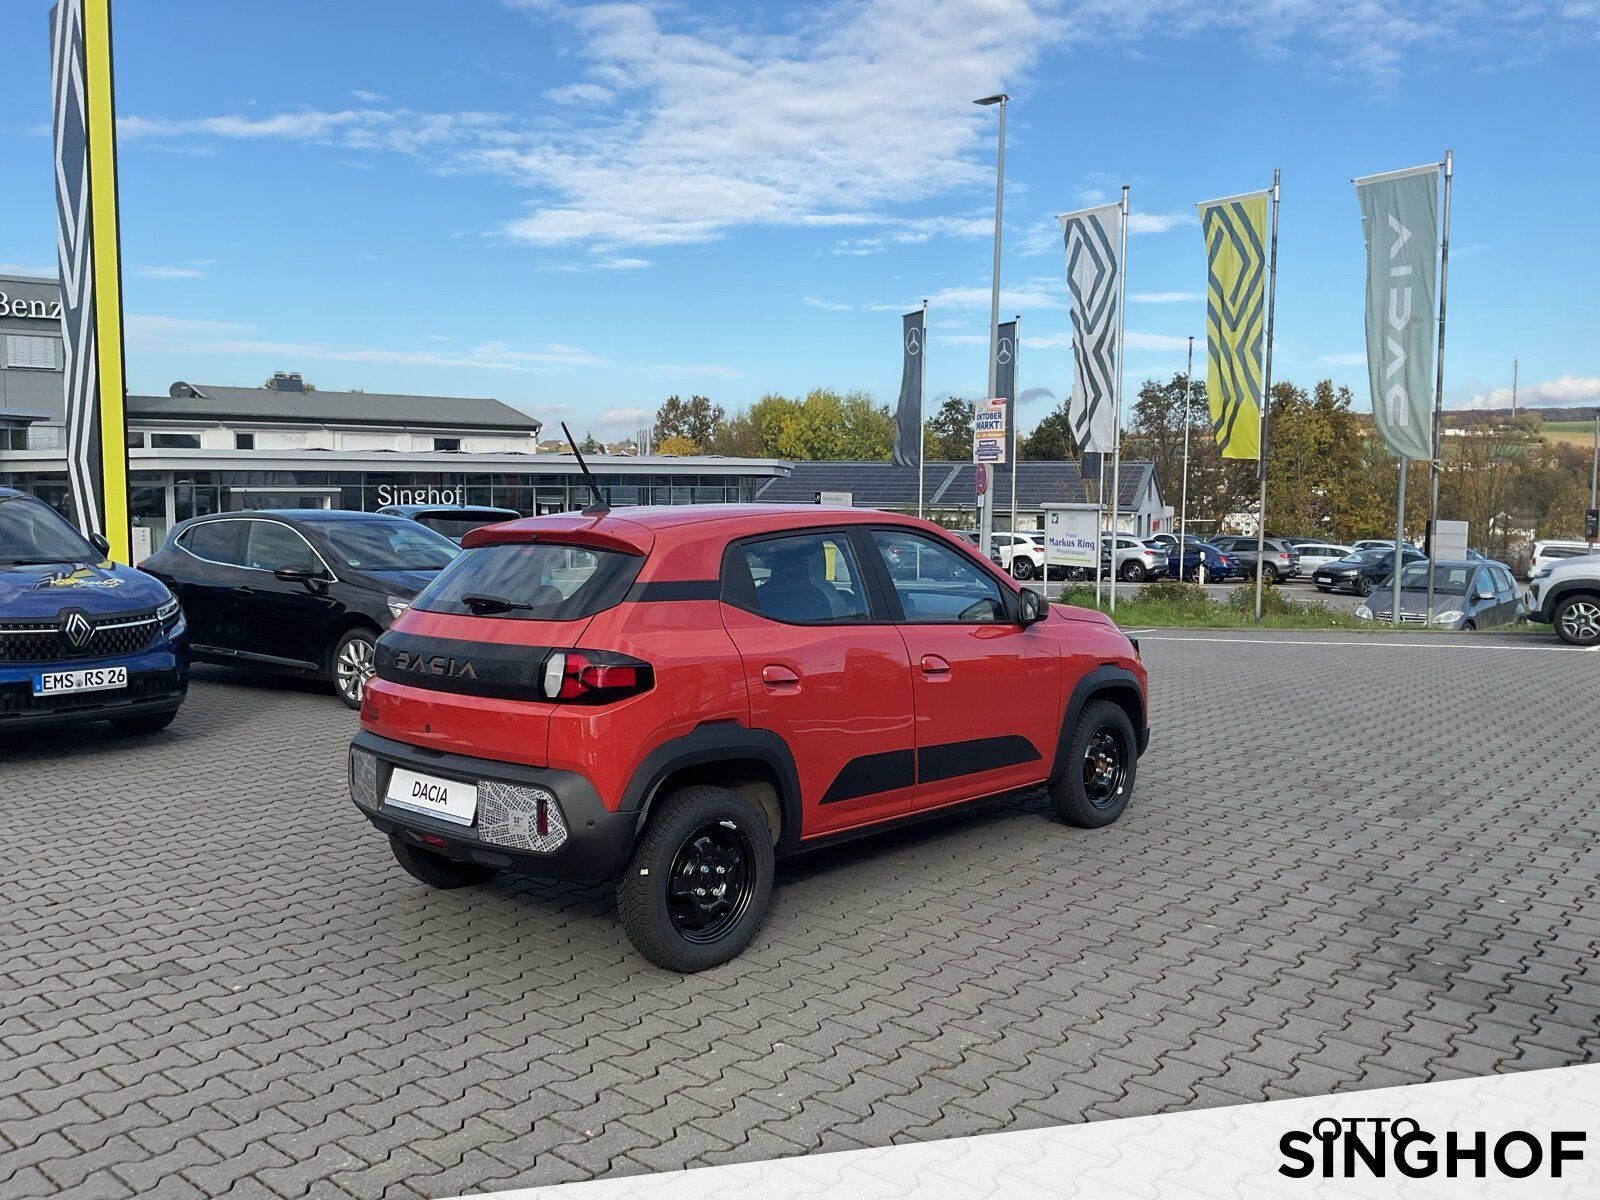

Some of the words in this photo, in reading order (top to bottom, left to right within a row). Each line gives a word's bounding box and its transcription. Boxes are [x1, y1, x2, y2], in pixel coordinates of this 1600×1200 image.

[377, 484, 463, 506] Singhof
[1049, 537, 1075, 548] Markus
[1077, 539, 1095, 551] Ring
[395, 649, 478, 680] DACIA
[43, 673, 74, 690] EMS
[84, 671, 104, 686] RS
[107, 669, 126, 684] 26
[411, 780, 448, 805] DACIA
